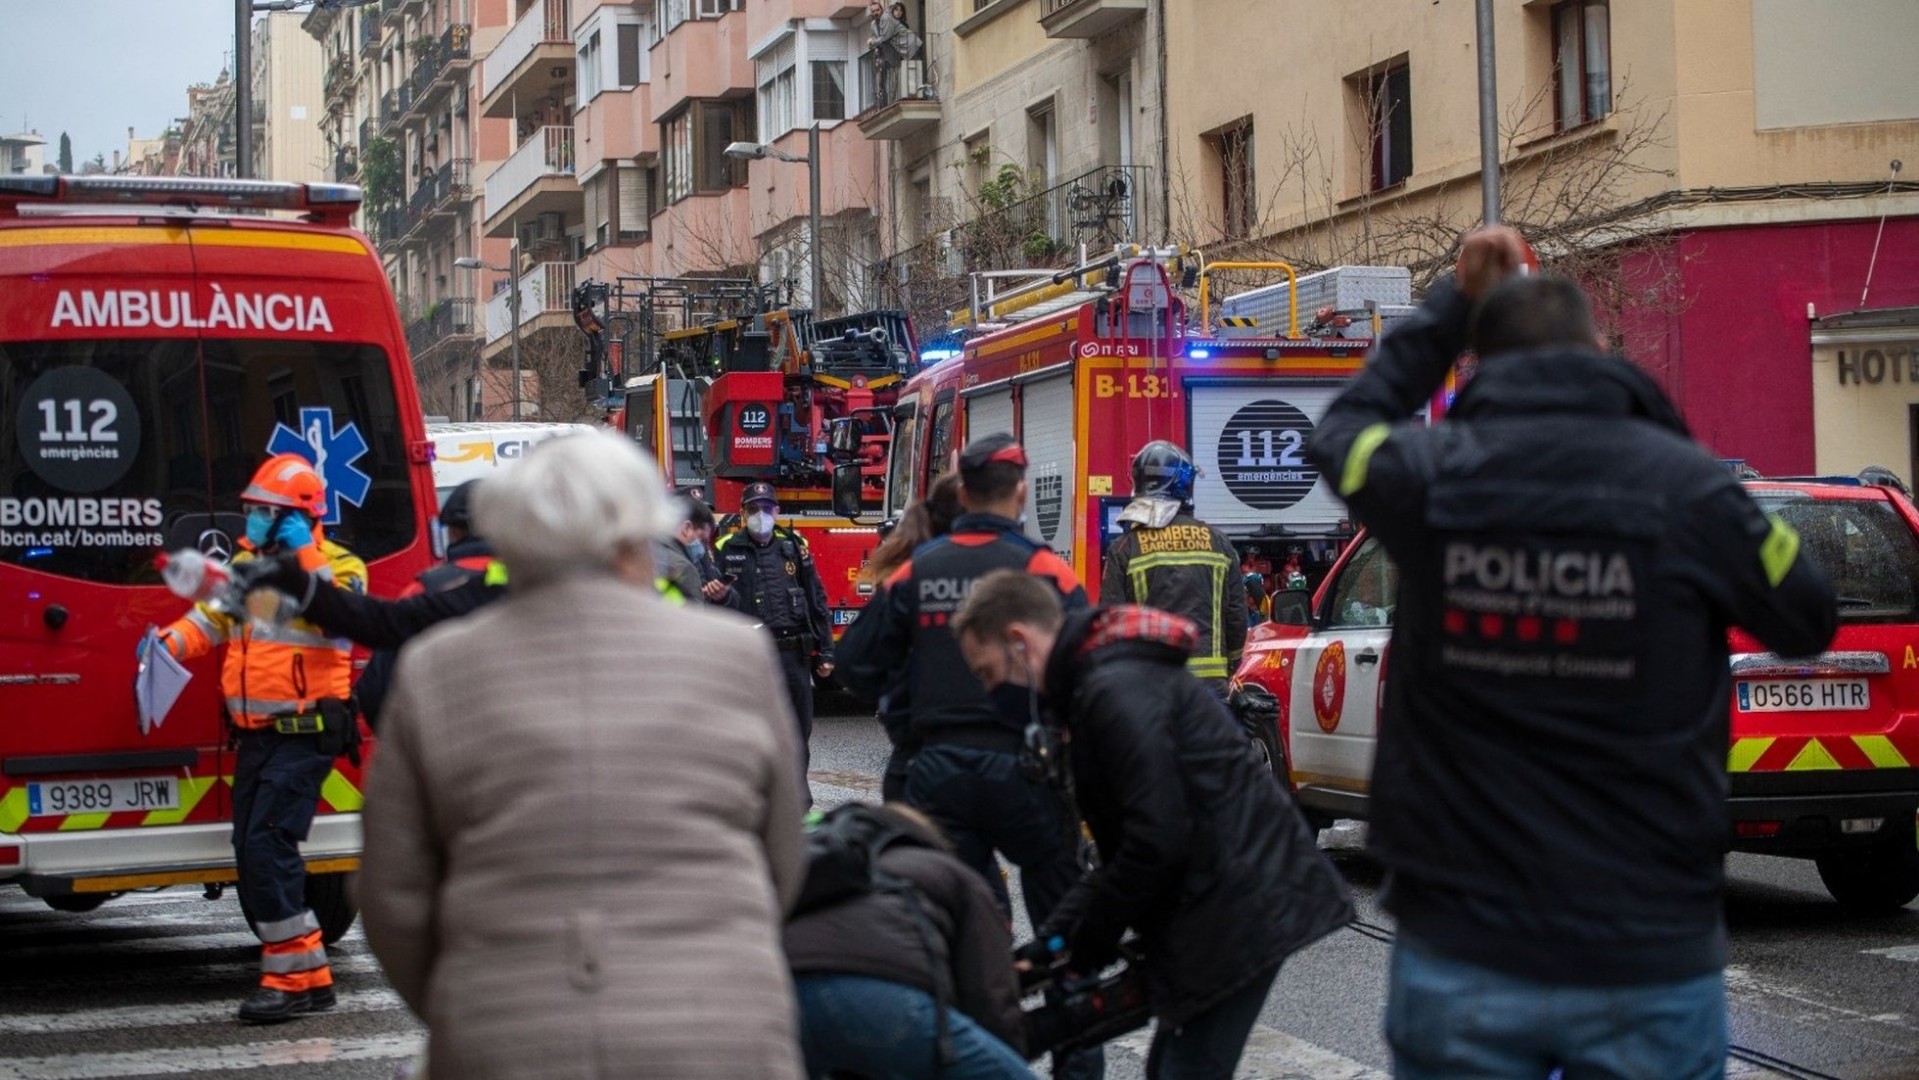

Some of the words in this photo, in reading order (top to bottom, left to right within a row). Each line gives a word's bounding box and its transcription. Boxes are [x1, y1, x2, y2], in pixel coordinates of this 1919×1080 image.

[51, 282, 333, 333] AMBULÀNCIA
[38, 398, 119, 442] 112
[743, 411, 766, 423] 112
[40, 445, 119, 461] emergències
[1237, 429, 1303, 467] 112
[1237, 468, 1303, 483] emergències
[0, 498, 164, 526] BOMBERS
[0, 527, 164, 548] bcn.cat/bombers
[1137, 525, 1211, 544] BOMBERS
[1141, 540, 1212, 554] BARCELONA
[1444, 543, 1636, 597] POLICIA
[1754, 684, 1813, 707] 0566
[1822, 683, 1865, 706] HTR
[50, 783, 113, 811] 9389
[126, 780, 170, 807] JRW
